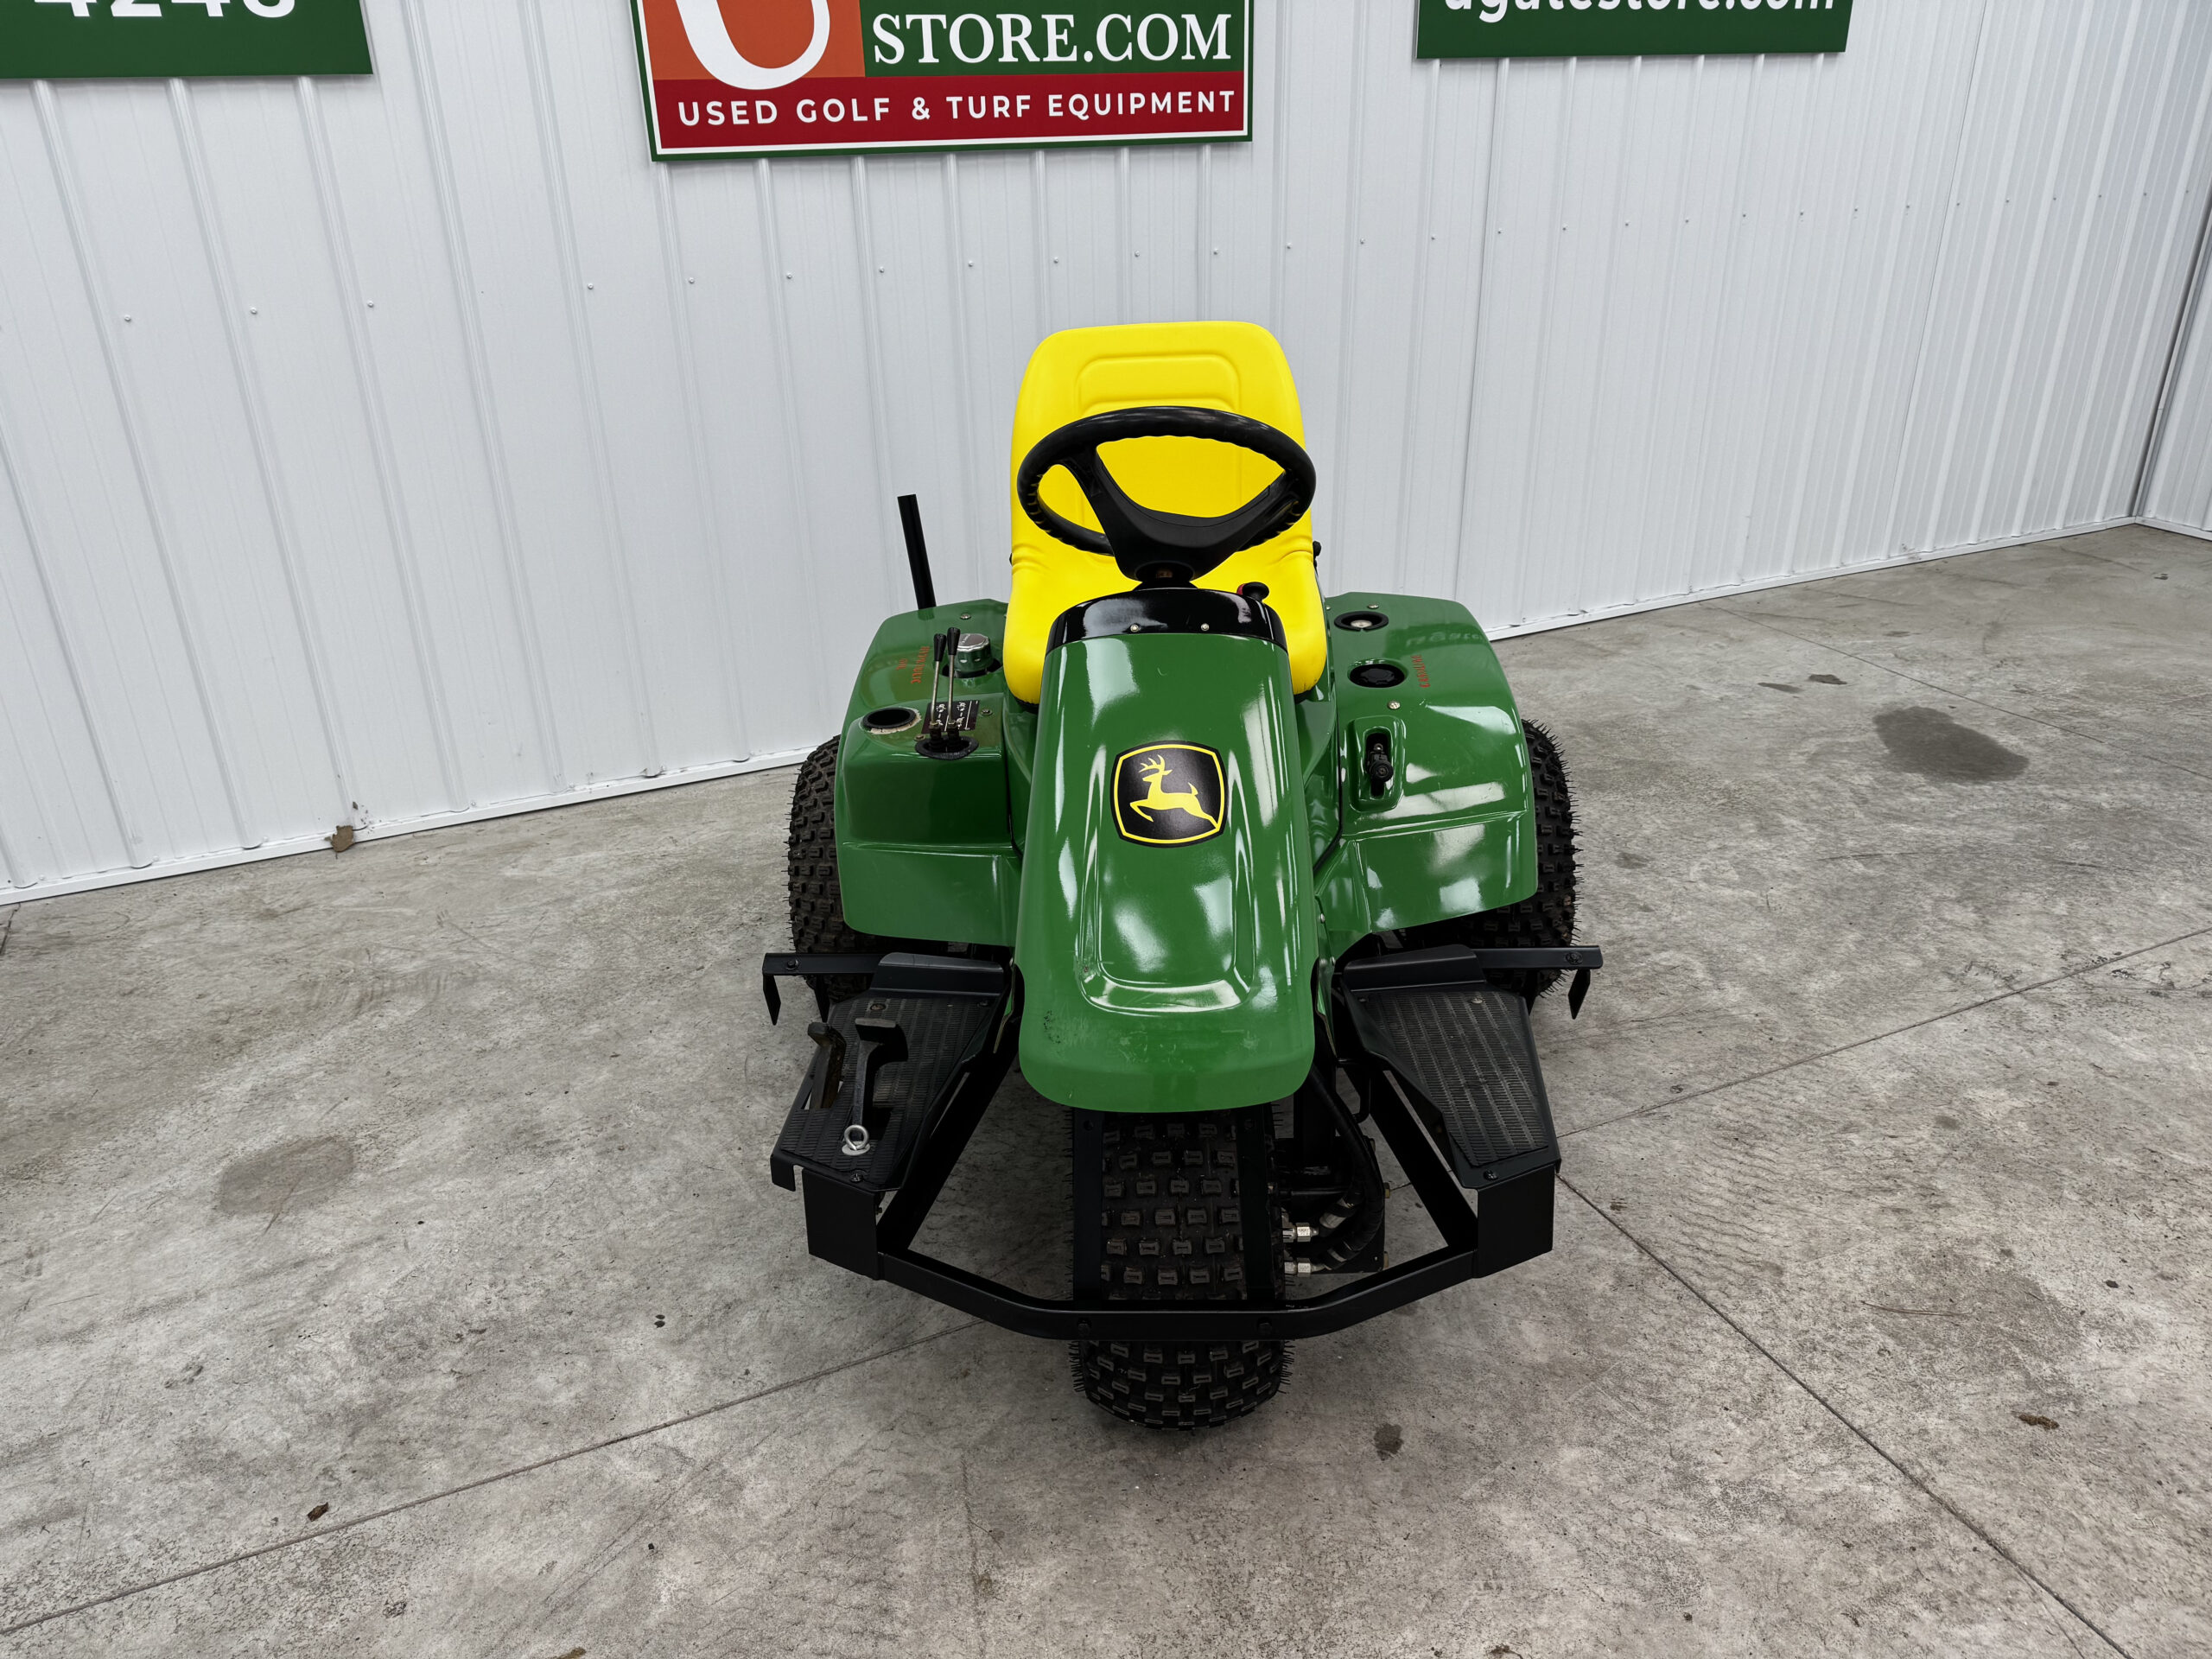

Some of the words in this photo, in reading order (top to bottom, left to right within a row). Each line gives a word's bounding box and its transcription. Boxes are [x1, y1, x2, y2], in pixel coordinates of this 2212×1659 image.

[873, 13, 1232, 65] STORE.COM
[677, 100, 778, 126] USED
[796, 98, 890, 124] GOLF
[912, 97, 931, 120] &
[945, 94, 1031, 119] TURF
[1048, 90, 1235, 121] EQUIPMENT
